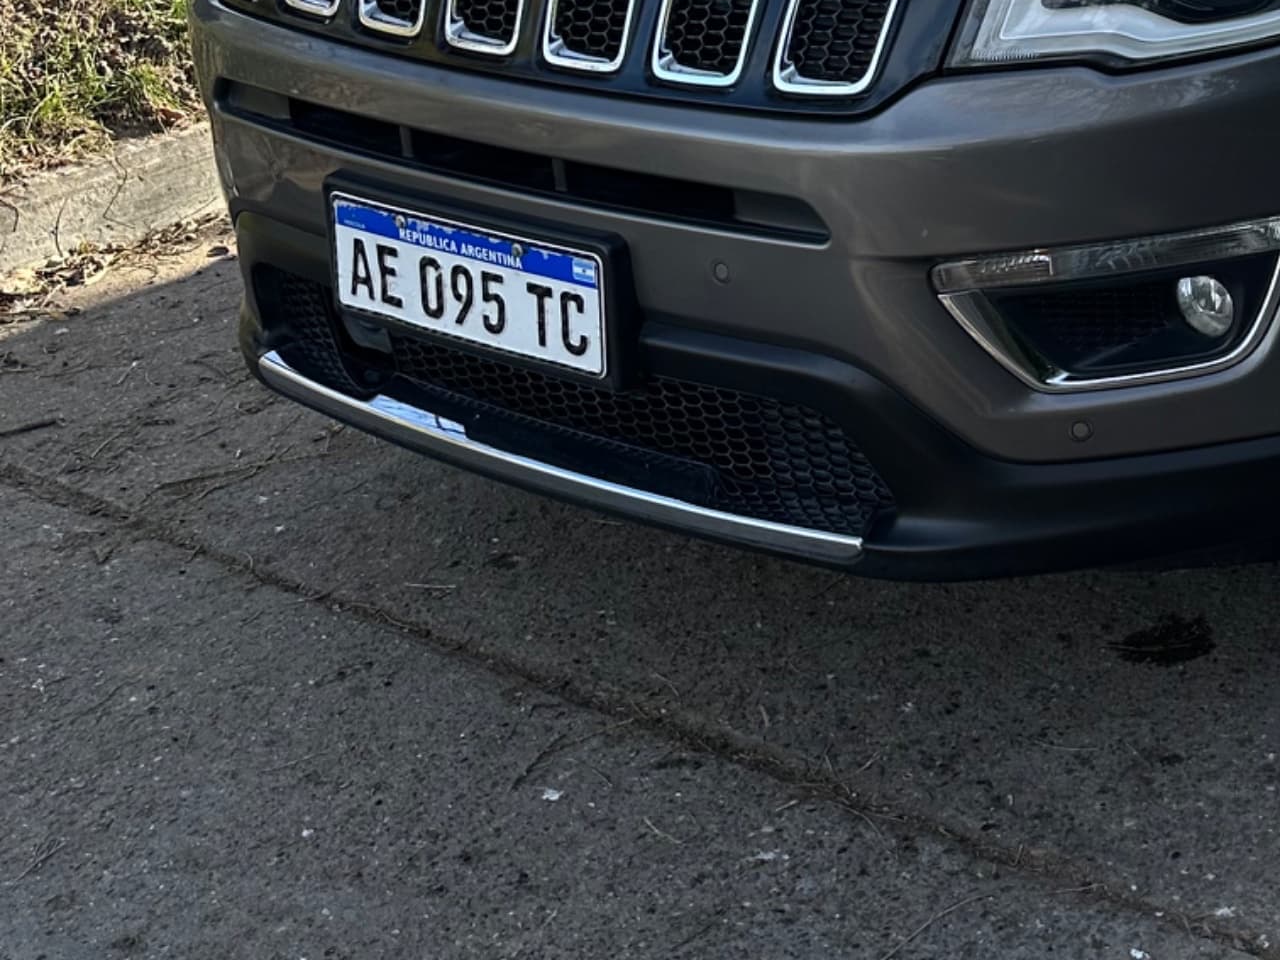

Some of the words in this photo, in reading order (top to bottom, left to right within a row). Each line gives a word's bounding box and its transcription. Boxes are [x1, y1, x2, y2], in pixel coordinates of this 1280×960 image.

[461, 243, 523, 269] ARGENTINA
[350, 237, 404, 309] AE
[418, 254, 507, 336] 095
[526, 281, 589, 357] TC
